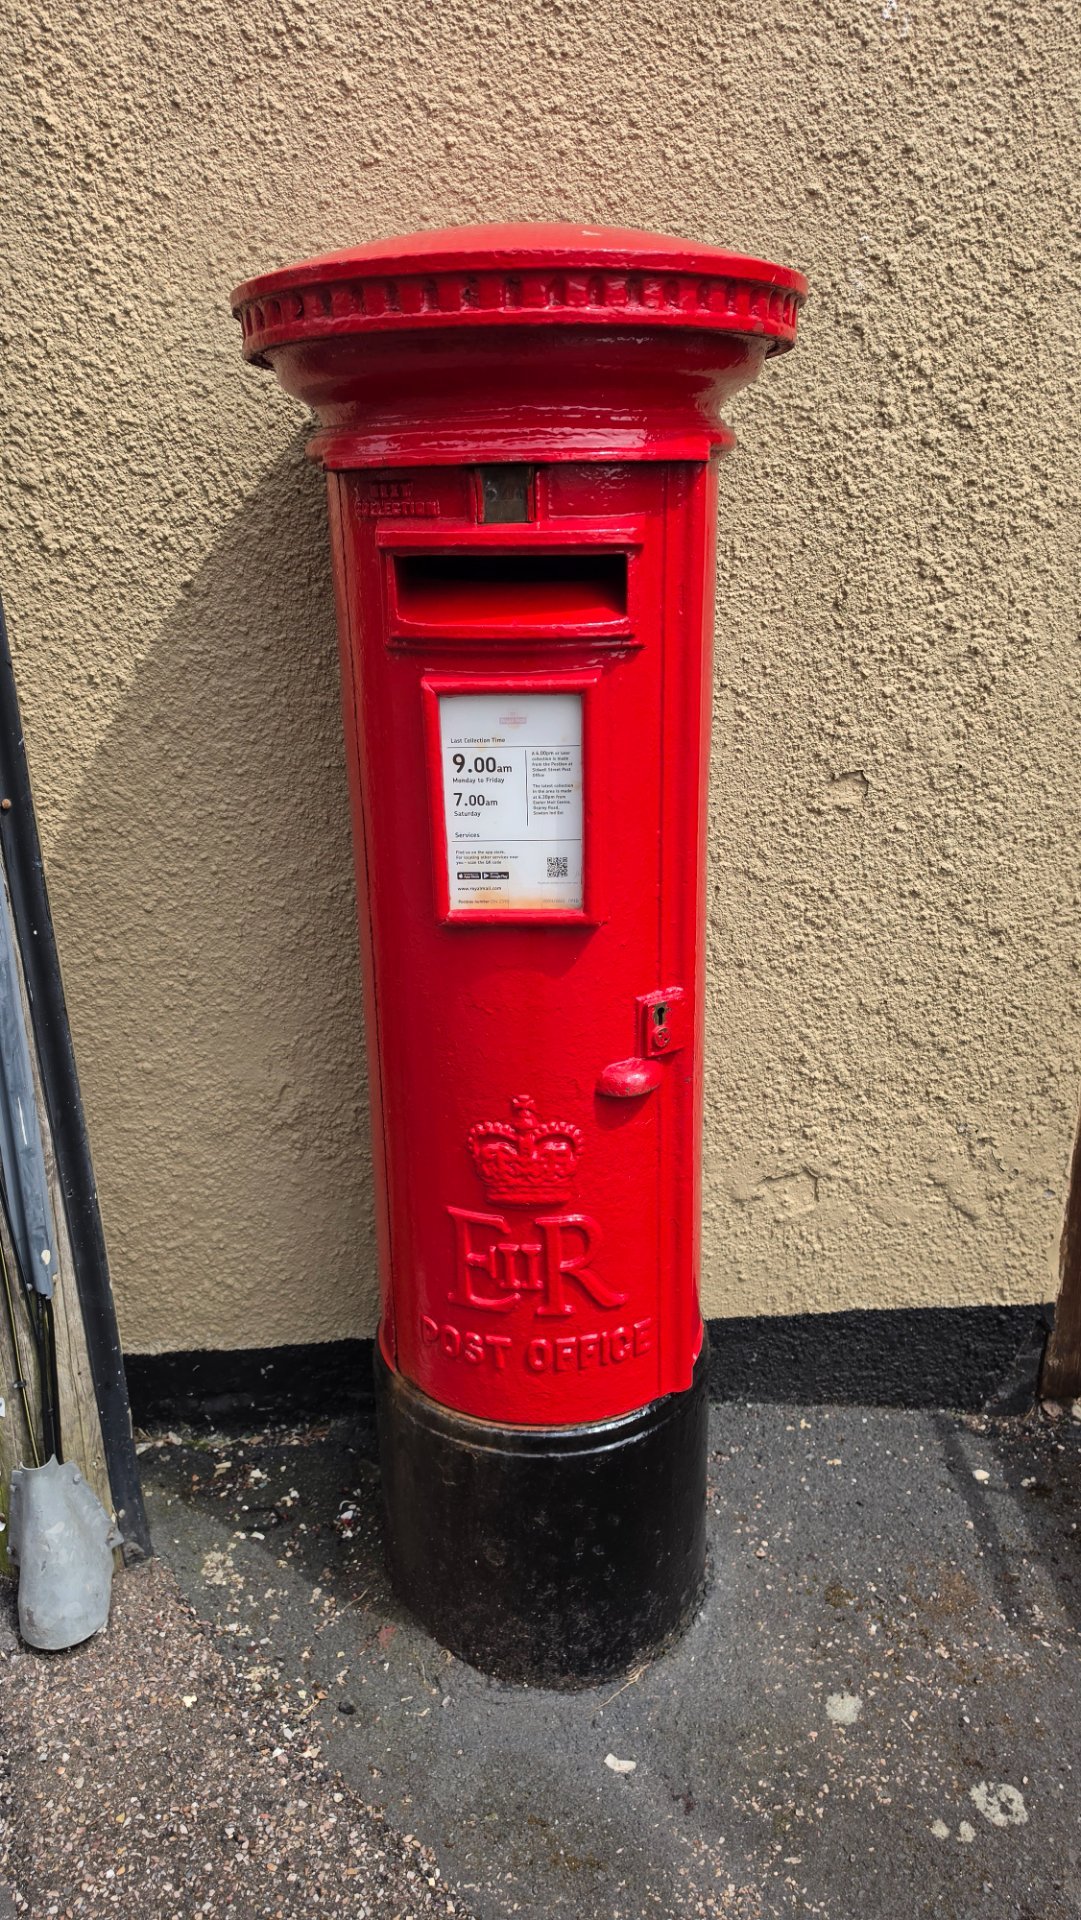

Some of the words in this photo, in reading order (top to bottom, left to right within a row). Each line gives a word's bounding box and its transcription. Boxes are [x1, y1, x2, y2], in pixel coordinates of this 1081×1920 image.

[452, 753, 513, 773] 9.00am
[453, 793, 498, 807] 7.00am
[421, 1315, 512, 1371] POST
[524, 1317, 652, 1372] OFFICE
